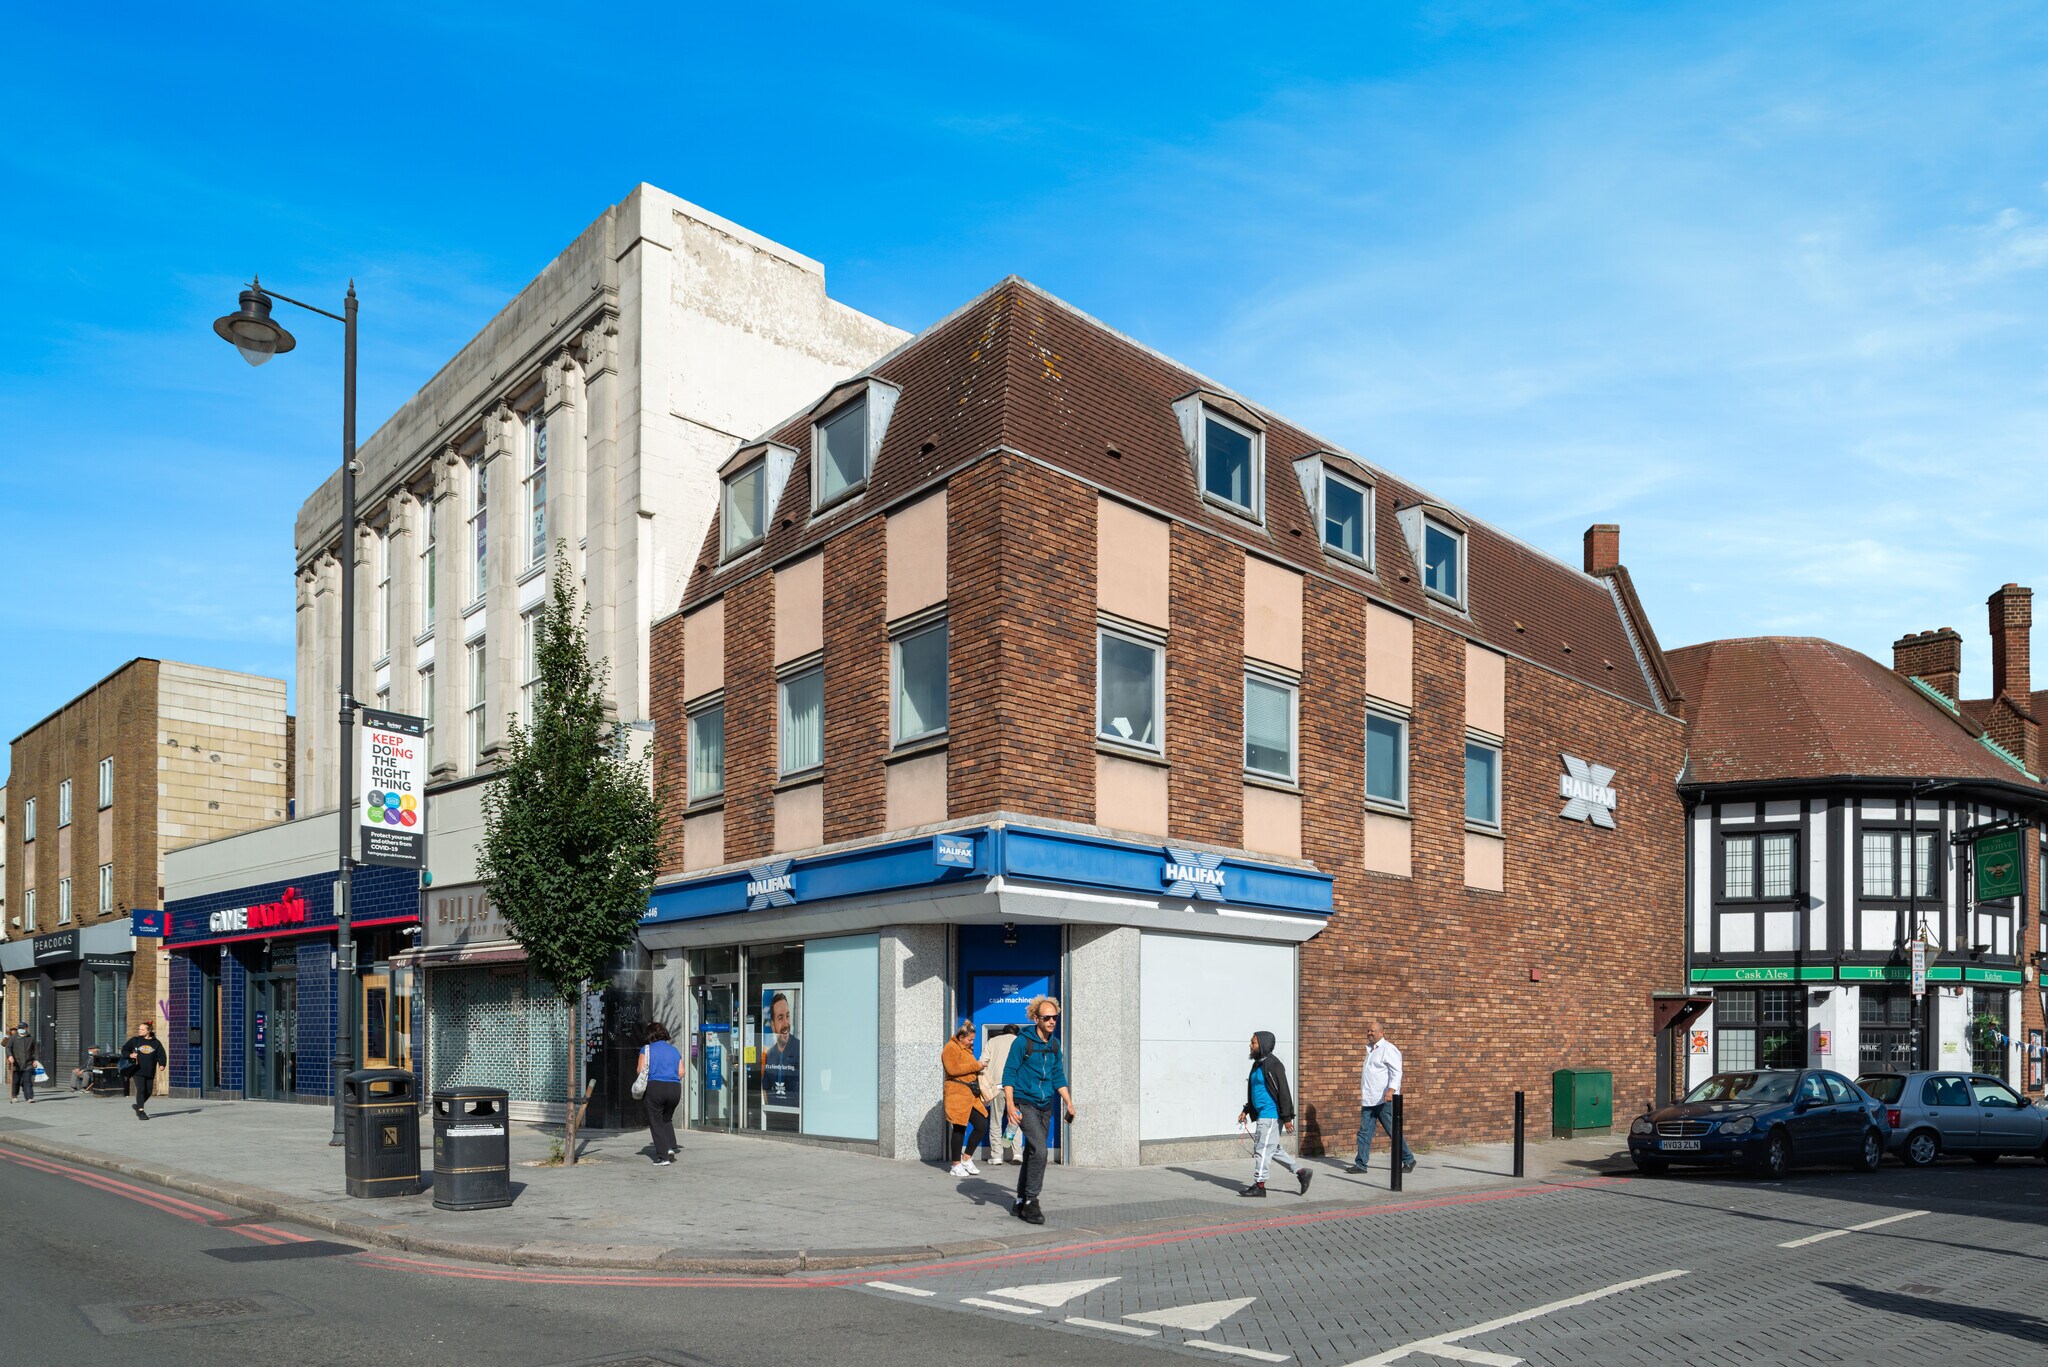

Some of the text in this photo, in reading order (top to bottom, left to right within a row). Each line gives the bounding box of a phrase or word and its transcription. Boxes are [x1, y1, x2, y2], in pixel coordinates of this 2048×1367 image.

[372, 733, 404, 746] KEEP
[372, 744, 413, 760] DOING
[372, 755, 398, 768] THE
[372, 766, 411, 780] RIGHT
[371, 777, 412, 792] THING
[1560, 774, 1617, 810] HALIFAX
[370, 831, 391, 839] Protect
[370, 844, 399, 852] COVID-19
[939, 846, 972, 857] HALIFAX
[1981, 841, 2013, 853] BEEHIVE
[1166, 863, 1226, 886] HALIFAX
[747, 874, 792, 897] HALIFAX
[454, 924, 487, 938] ITLIAN
[35, 935, 72, 951] PEACOCKS
[1735, 969, 1788, 979] Cask Ales
[1868, 969, 1934, 978] THE BEEE
[1985, 971, 2003, 981] Kitchen
[1663, 1141, 1699, 1149] HV03 ZLN
